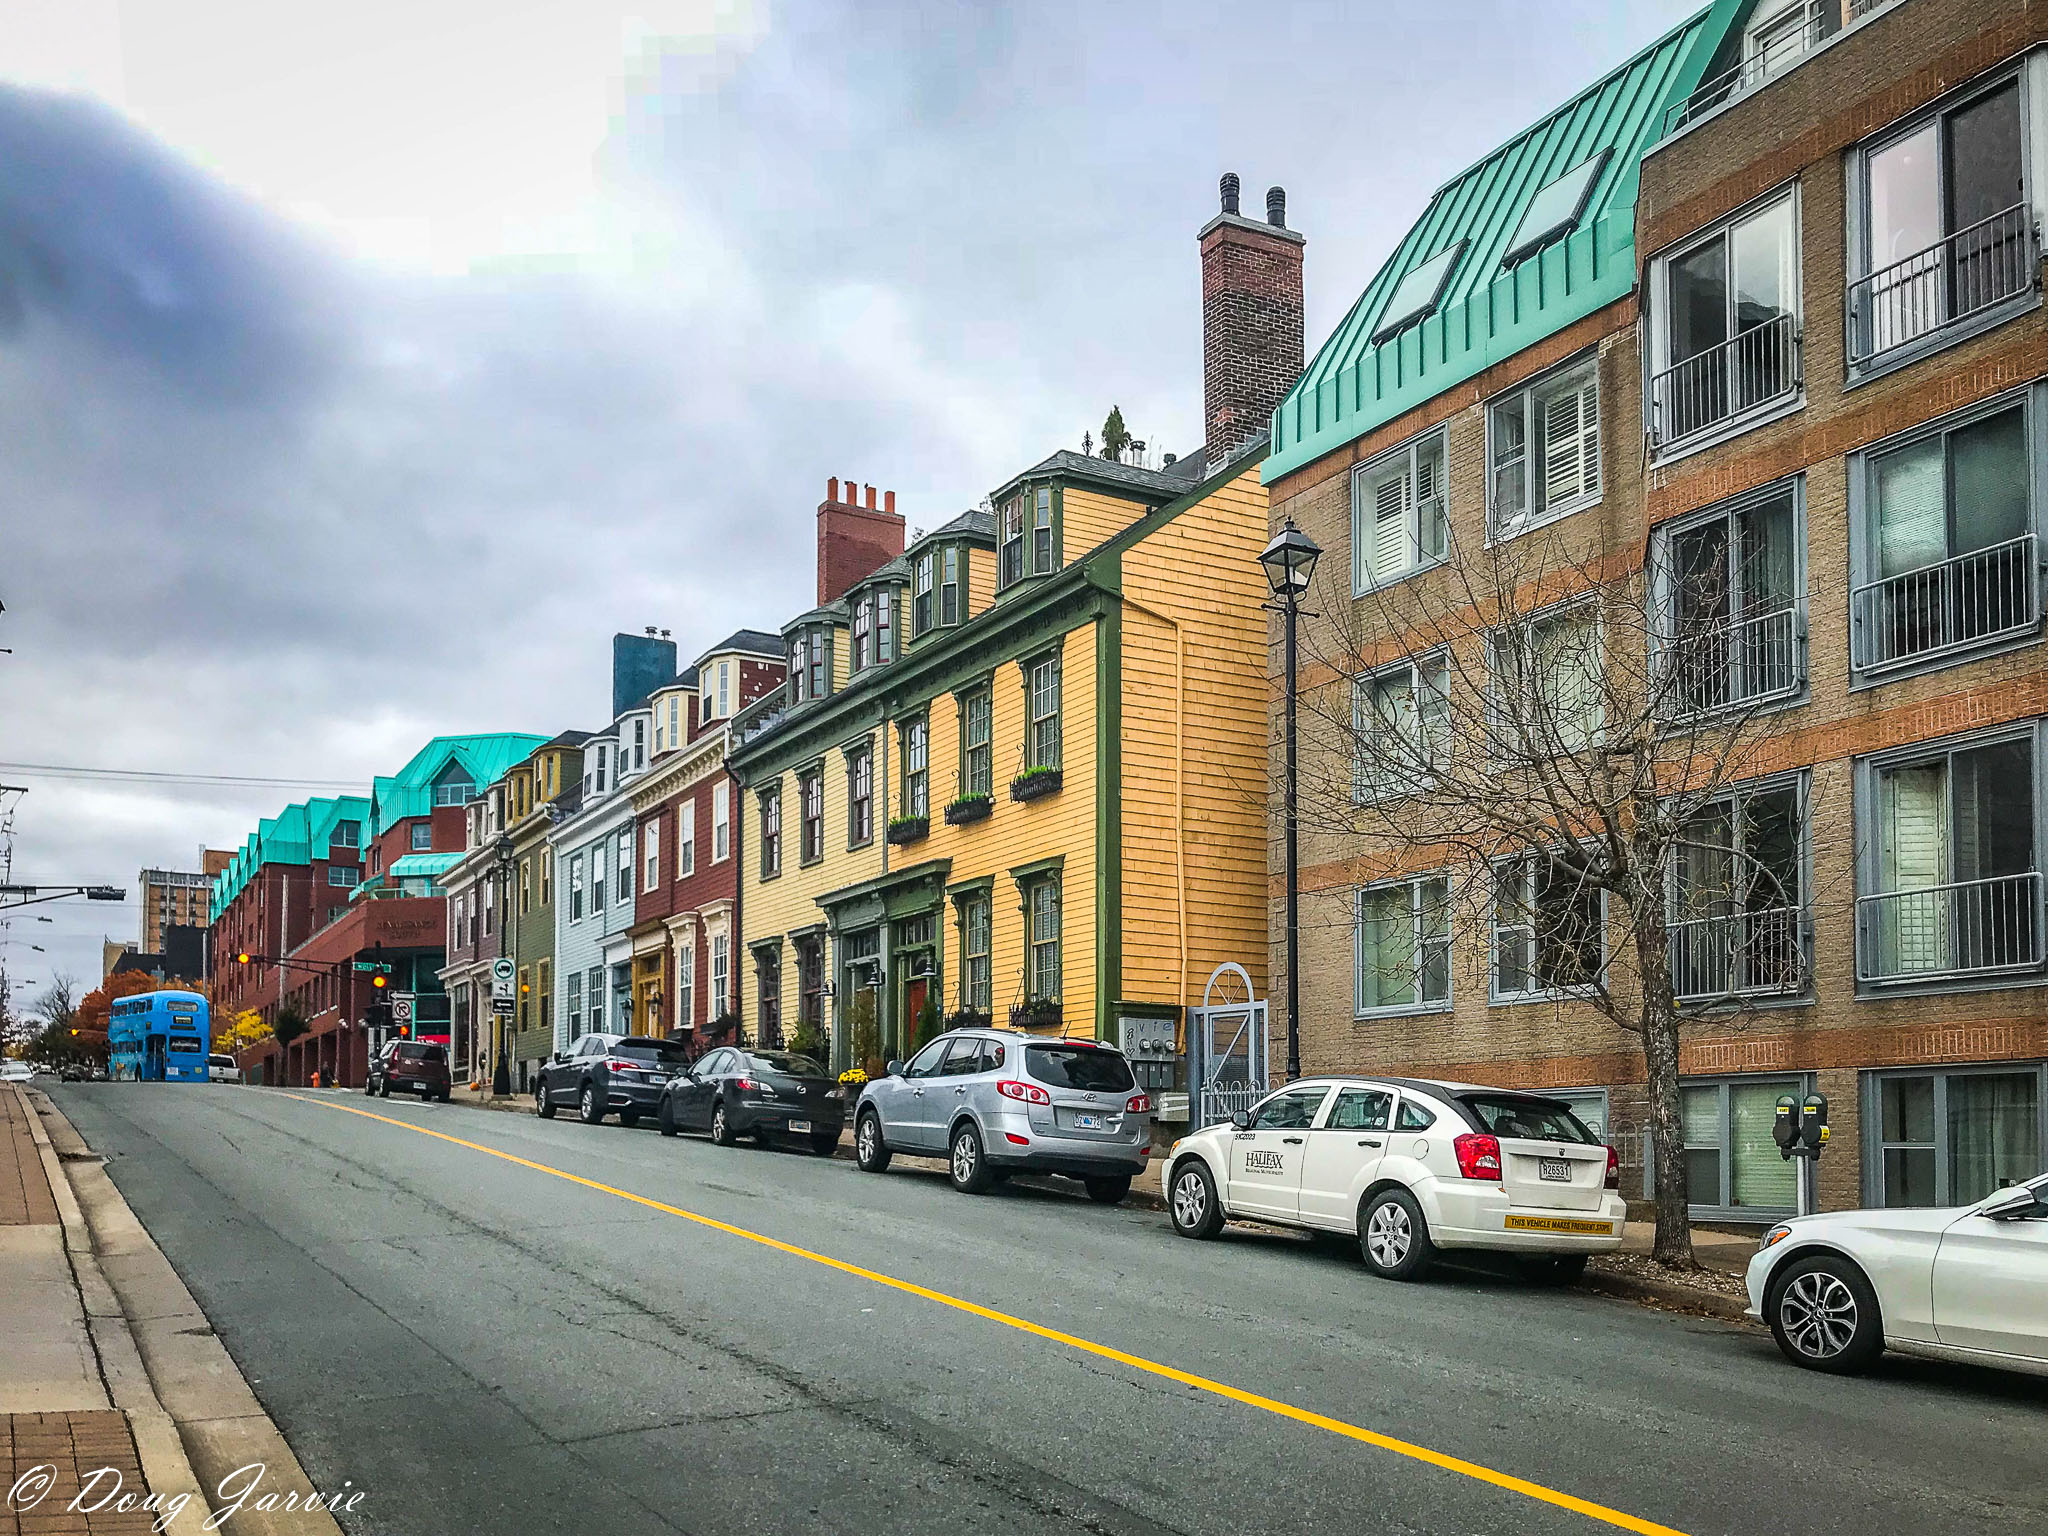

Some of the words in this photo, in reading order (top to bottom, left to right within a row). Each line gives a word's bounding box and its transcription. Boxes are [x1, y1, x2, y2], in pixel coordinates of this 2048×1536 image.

[1246, 1152, 1284, 1169] HALIFAX
[1543, 1164, 1569, 1176] R26531
[1511, 1218, 1525, 1226] THIS
[1526, 1219, 1550, 1228] VEHICLE
[1551, 1220, 1570, 1229] MAKES
[1571, 1222, 1595, 1231] FREQUENT
